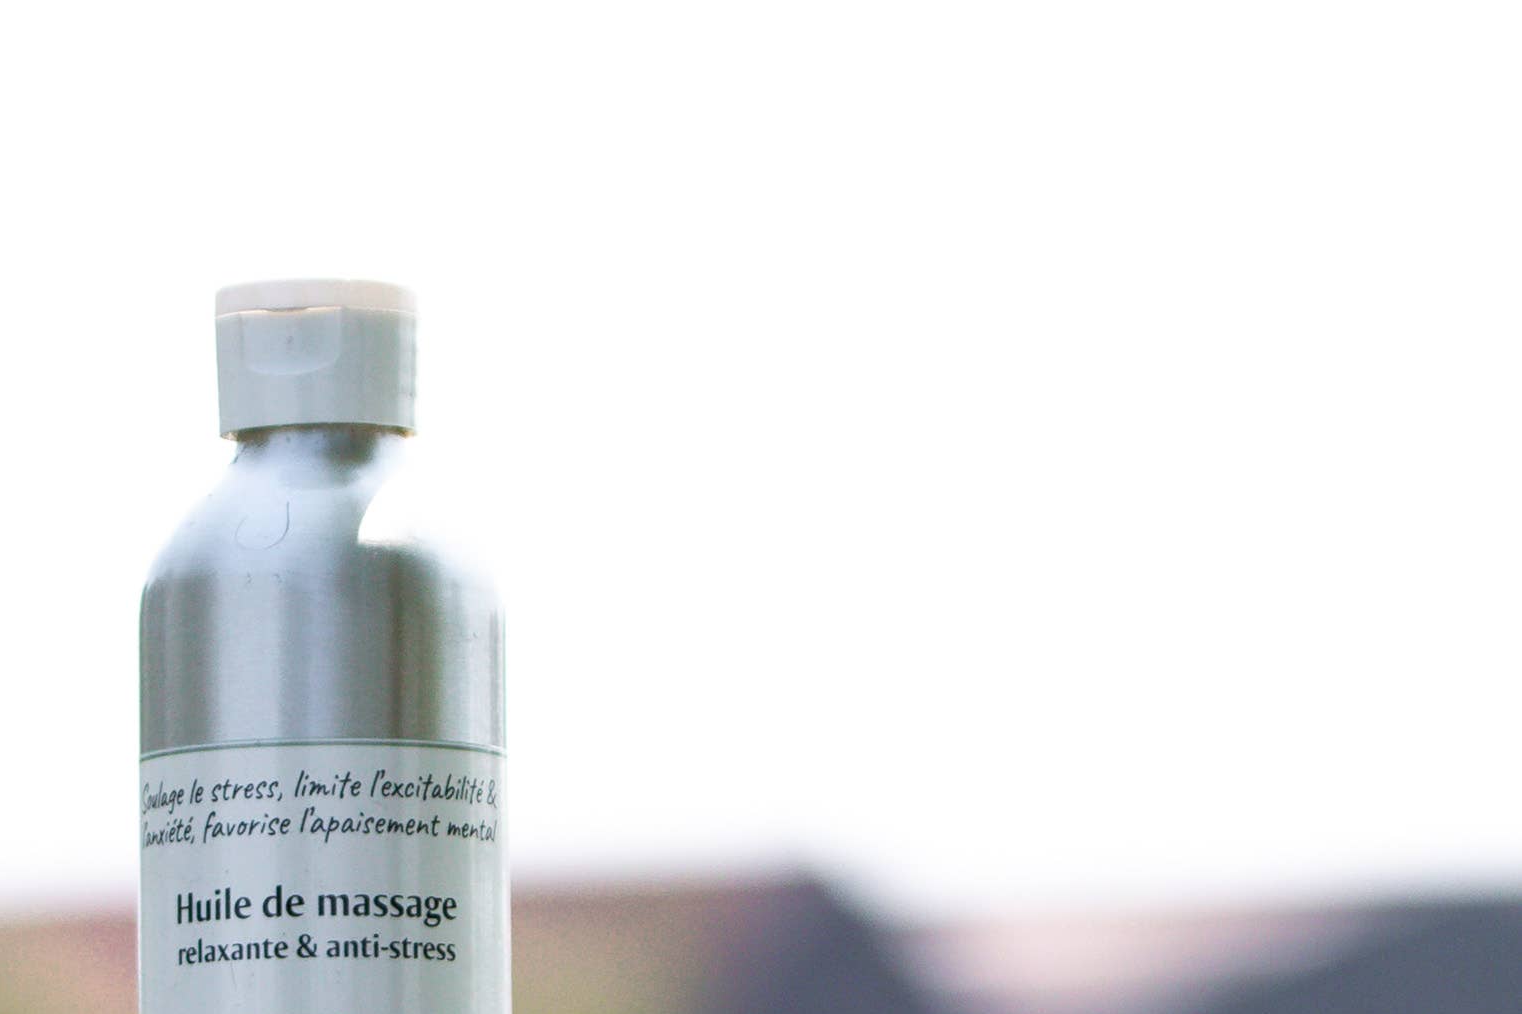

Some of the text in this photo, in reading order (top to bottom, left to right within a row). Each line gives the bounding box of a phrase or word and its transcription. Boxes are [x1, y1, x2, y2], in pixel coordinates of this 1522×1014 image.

[190, 779, 203, 804] le
[211, 778, 282, 802] stress,
[295, 770, 361, 798] limite
[370, 769, 484, 805] l'excitabilité
[487, 781, 498, 808] &
[203, 811, 291, 843] favorise
[300, 807, 439, 842] l'apaisement
[447, 819, 497, 842] mental
[176, 885, 457, 927] Huile de massage
[178, 934, 456, 965] relaxante & anti-stress
